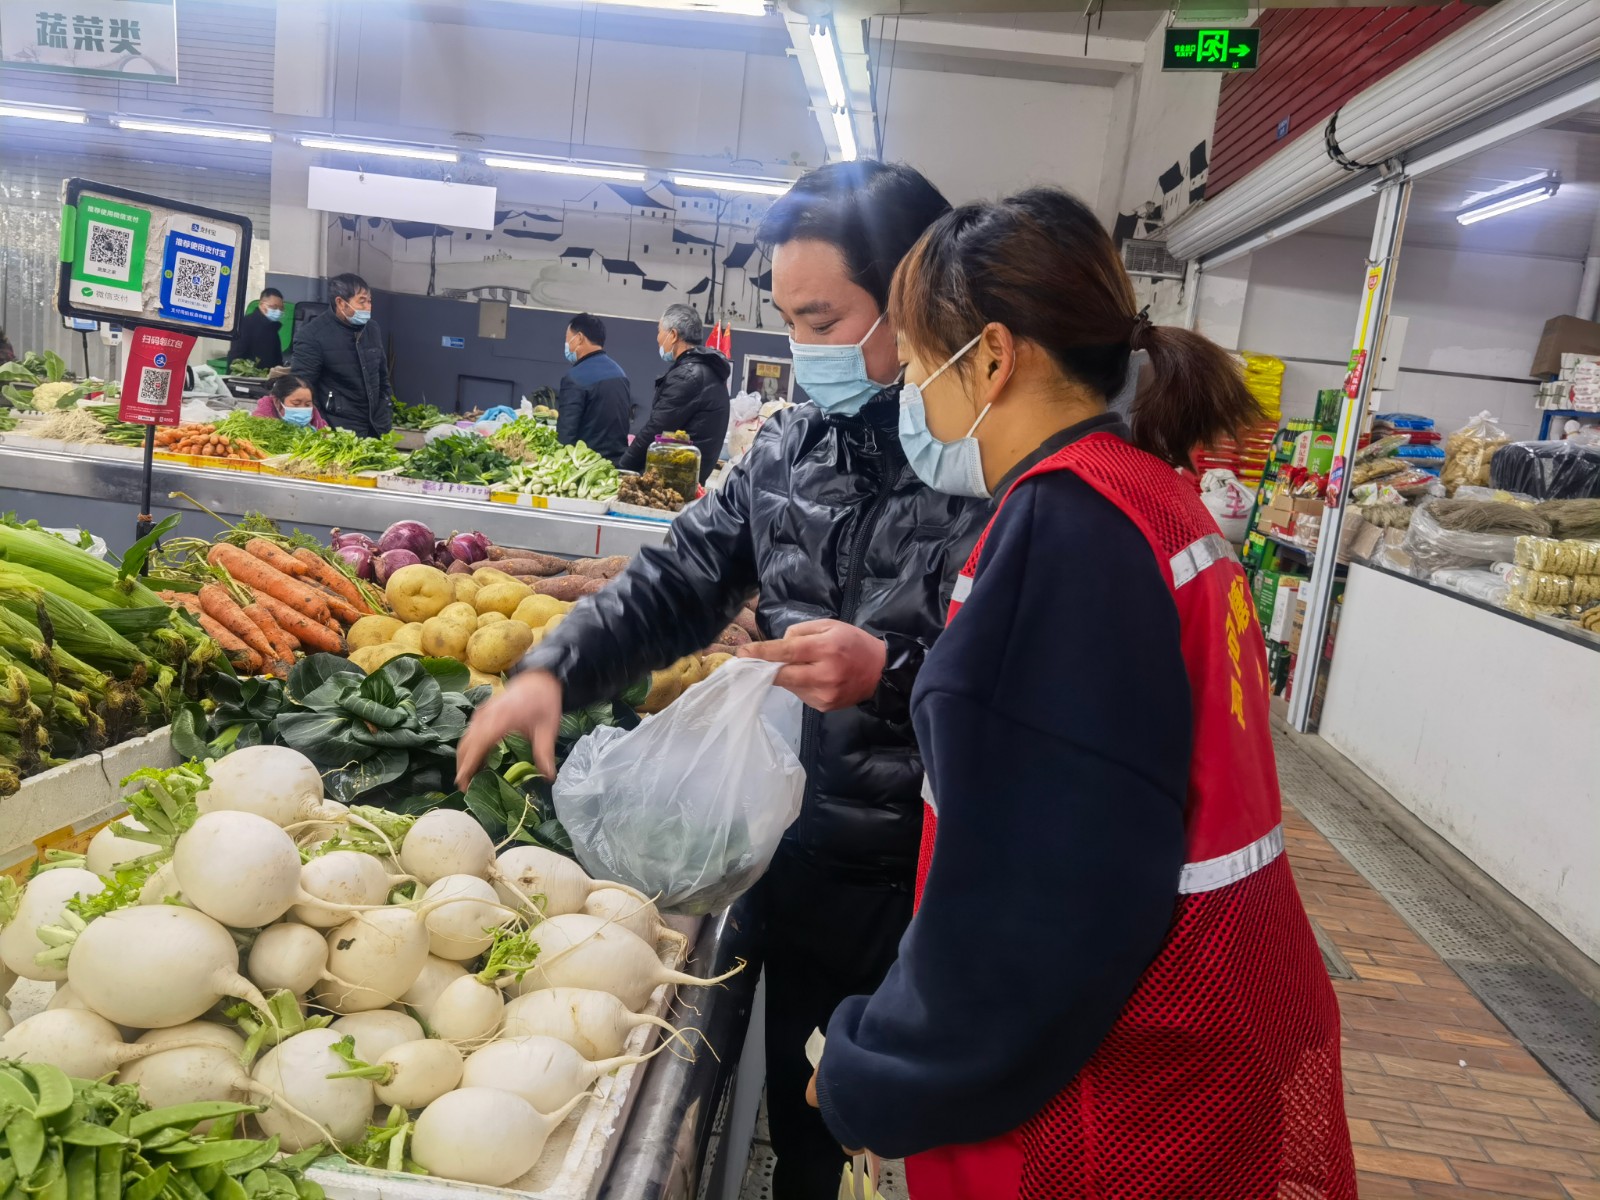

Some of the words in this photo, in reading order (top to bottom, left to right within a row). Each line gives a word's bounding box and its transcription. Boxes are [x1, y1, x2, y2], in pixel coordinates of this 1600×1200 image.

[36, 11, 142, 55] 蔬菜类
[87, 205, 139, 224] 推荐使用微信支付
[175, 237, 227, 258] 推荐使用支付宝
[95, 289, 128, 303] 微信支付
[141, 334, 184, 349] 扫码领红包
